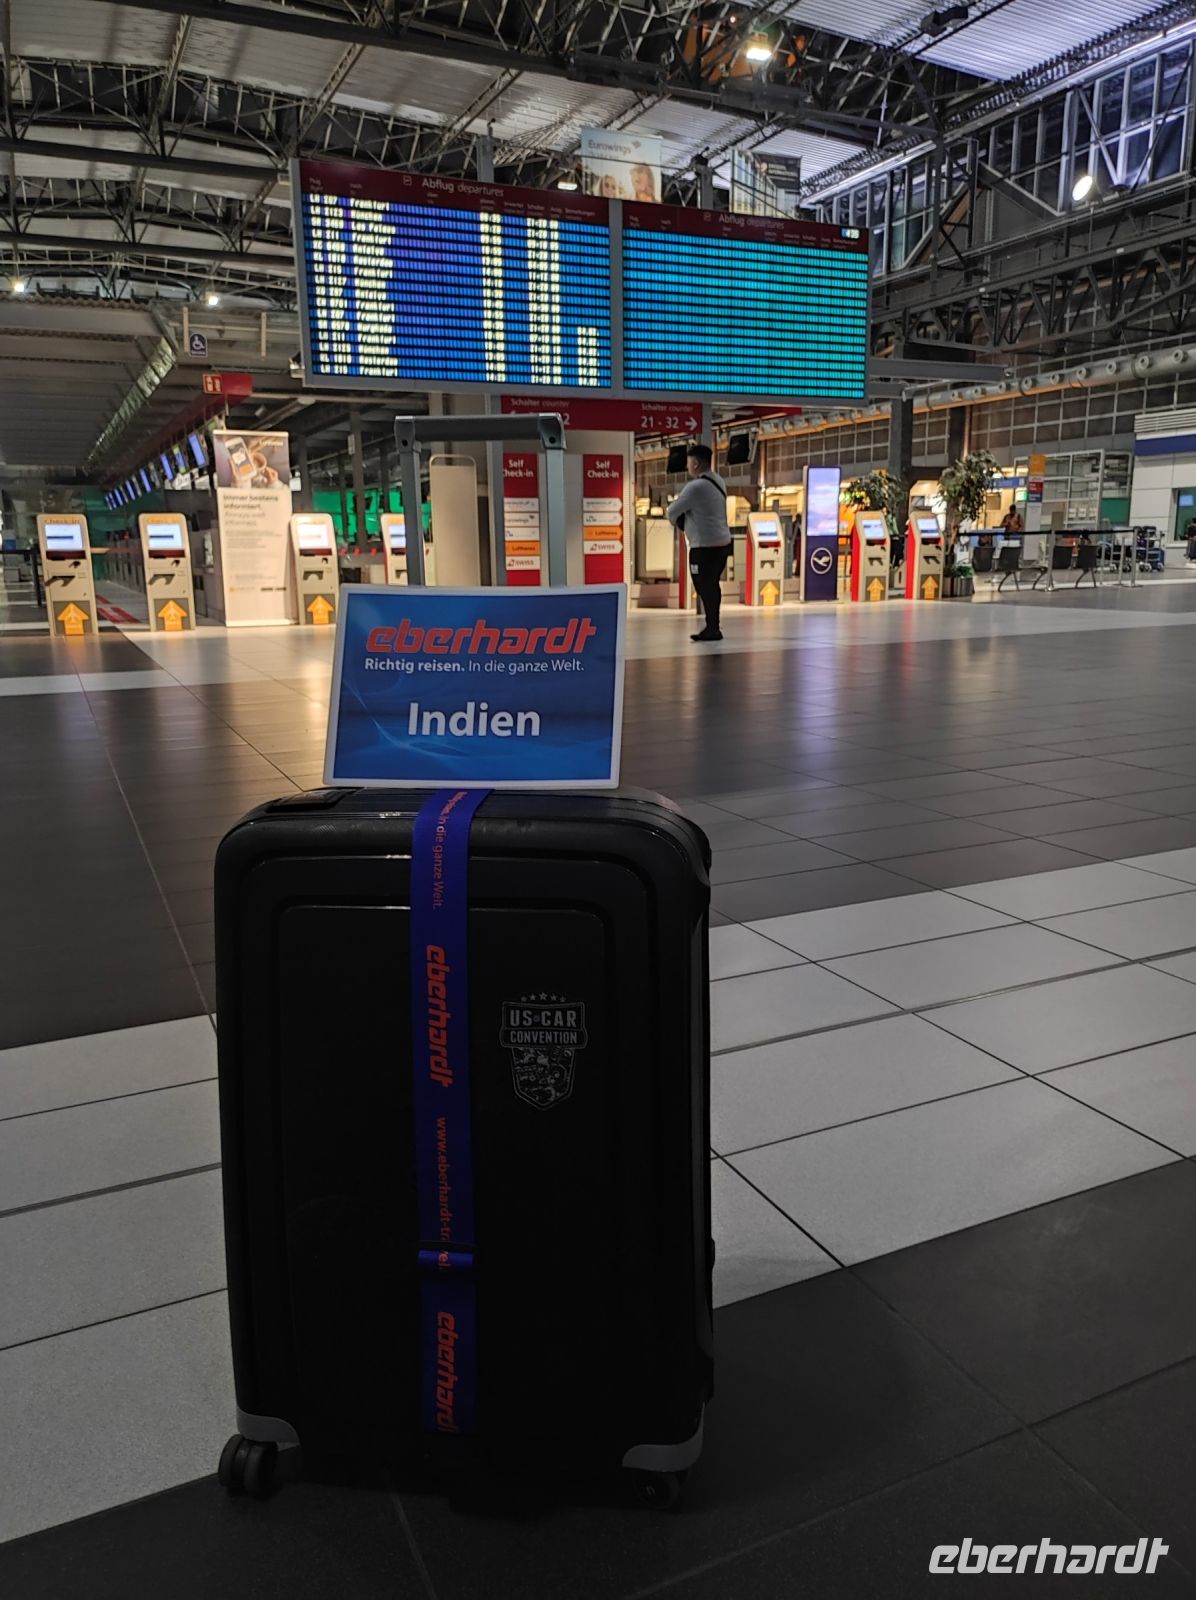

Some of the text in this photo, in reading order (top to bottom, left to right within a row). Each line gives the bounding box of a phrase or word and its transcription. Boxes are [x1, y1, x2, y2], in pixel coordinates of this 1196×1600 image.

[588, 139, 631, 156] Eurowings
[422, 177, 504, 198] Abflug departures
[310, 194, 319, 203] LH
[350, 198, 389, 210] Frankfurt
[310, 206, 320, 215] LH
[718, 213, 745, 228] Abflug
[312, 229, 322, 238] LH
[352, 233, 390, 244] Frankfurt
[314, 264, 324, 272] LH
[354, 267, 392, 278] Frankfurt
[315, 275, 324, 284] LH
[355, 300, 394, 311] Frankfurt
[317, 309, 327, 318] LH
[356, 311, 394, 322] Frankfurt
[318, 332, 328, 340] LH
[357, 334, 395, 343] Frankfurt
[319, 343, 328, 351] LH
[359, 367, 397, 375] Frankfurt
[511, 398, 570, 408] Schalter counter
[641, 403, 668, 412] Schalter
[641, 416, 654, 428] 21
[666, 416, 679, 429] 32
[508, 458, 524, 468] Self
[596, 460, 610, 469] Self
[586, 470, 619, 479] Check-in
[366, 617, 597, 655] eberhardt
[364, 657, 584, 675] Richtig reisen. In die ganze Welt.
[408, 702, 540, 737] Indien
[436, 826, 448, 842] die
[432, 844, 446, 880] ganze
[426, 944, 454, 1088] eberhardt
[510, 1008, 578, 1028] US CAR
[510, 1030, 578, 1045] CONVENTION
